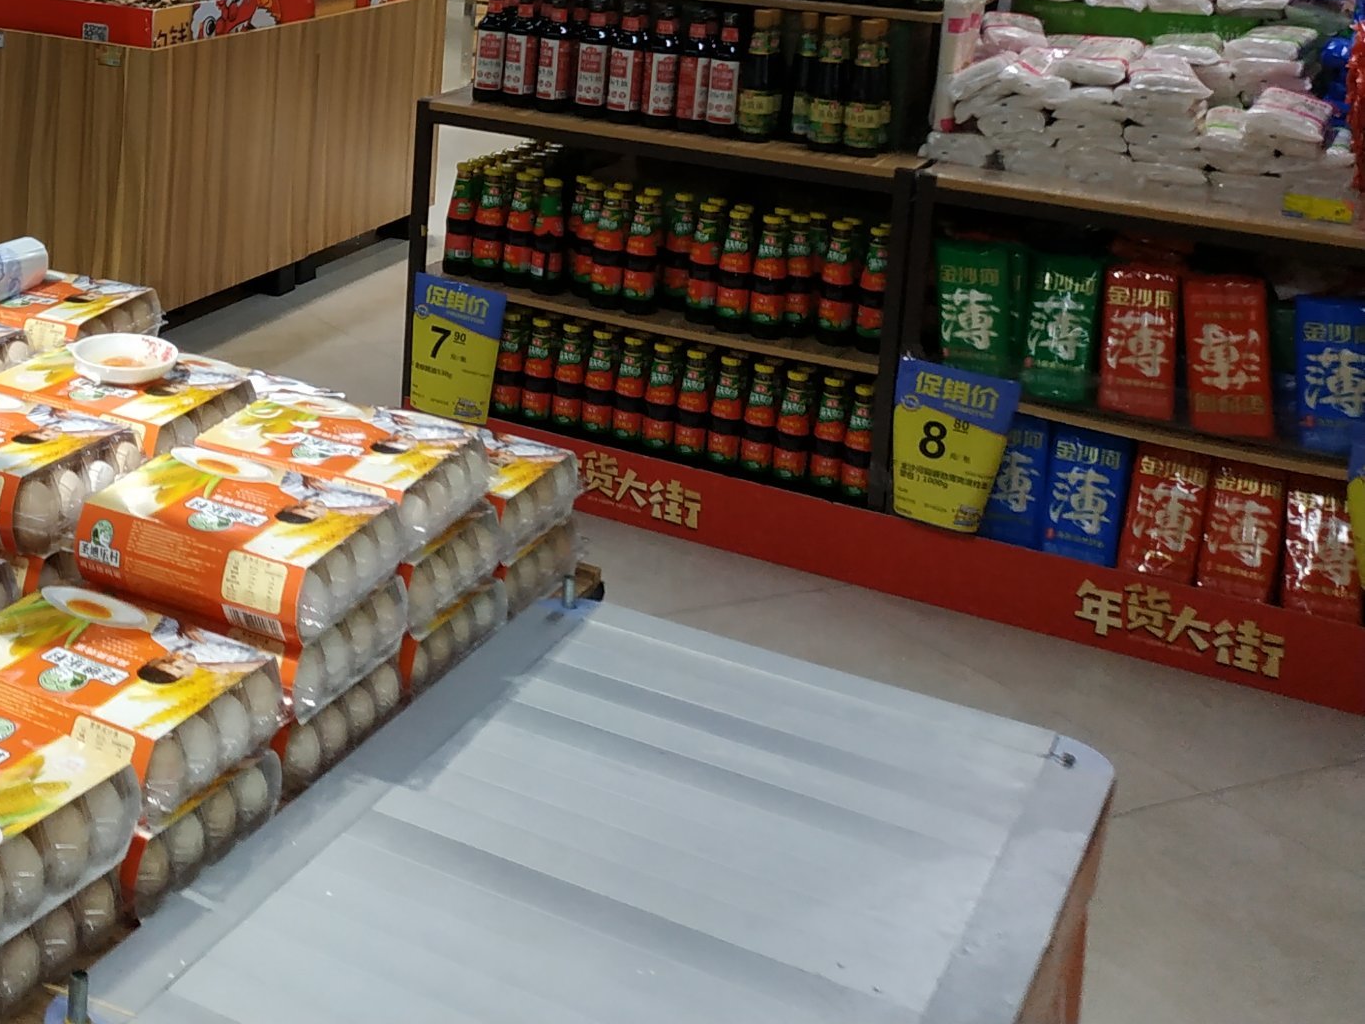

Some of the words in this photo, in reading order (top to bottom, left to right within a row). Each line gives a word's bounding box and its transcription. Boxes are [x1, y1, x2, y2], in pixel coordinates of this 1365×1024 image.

[426, 284, 490, 318] 促销价
[430, 325, 451, 360] 7
[453, 331, 467, 345] 90
[915, 371, 1000, 412] 促销价
[919, 420, 947, 459] 8
[953, 418, 970, 433] 80
[577, 449, 701, 529] 货大街
[1075, 579, 1285, 678] 年货大街
